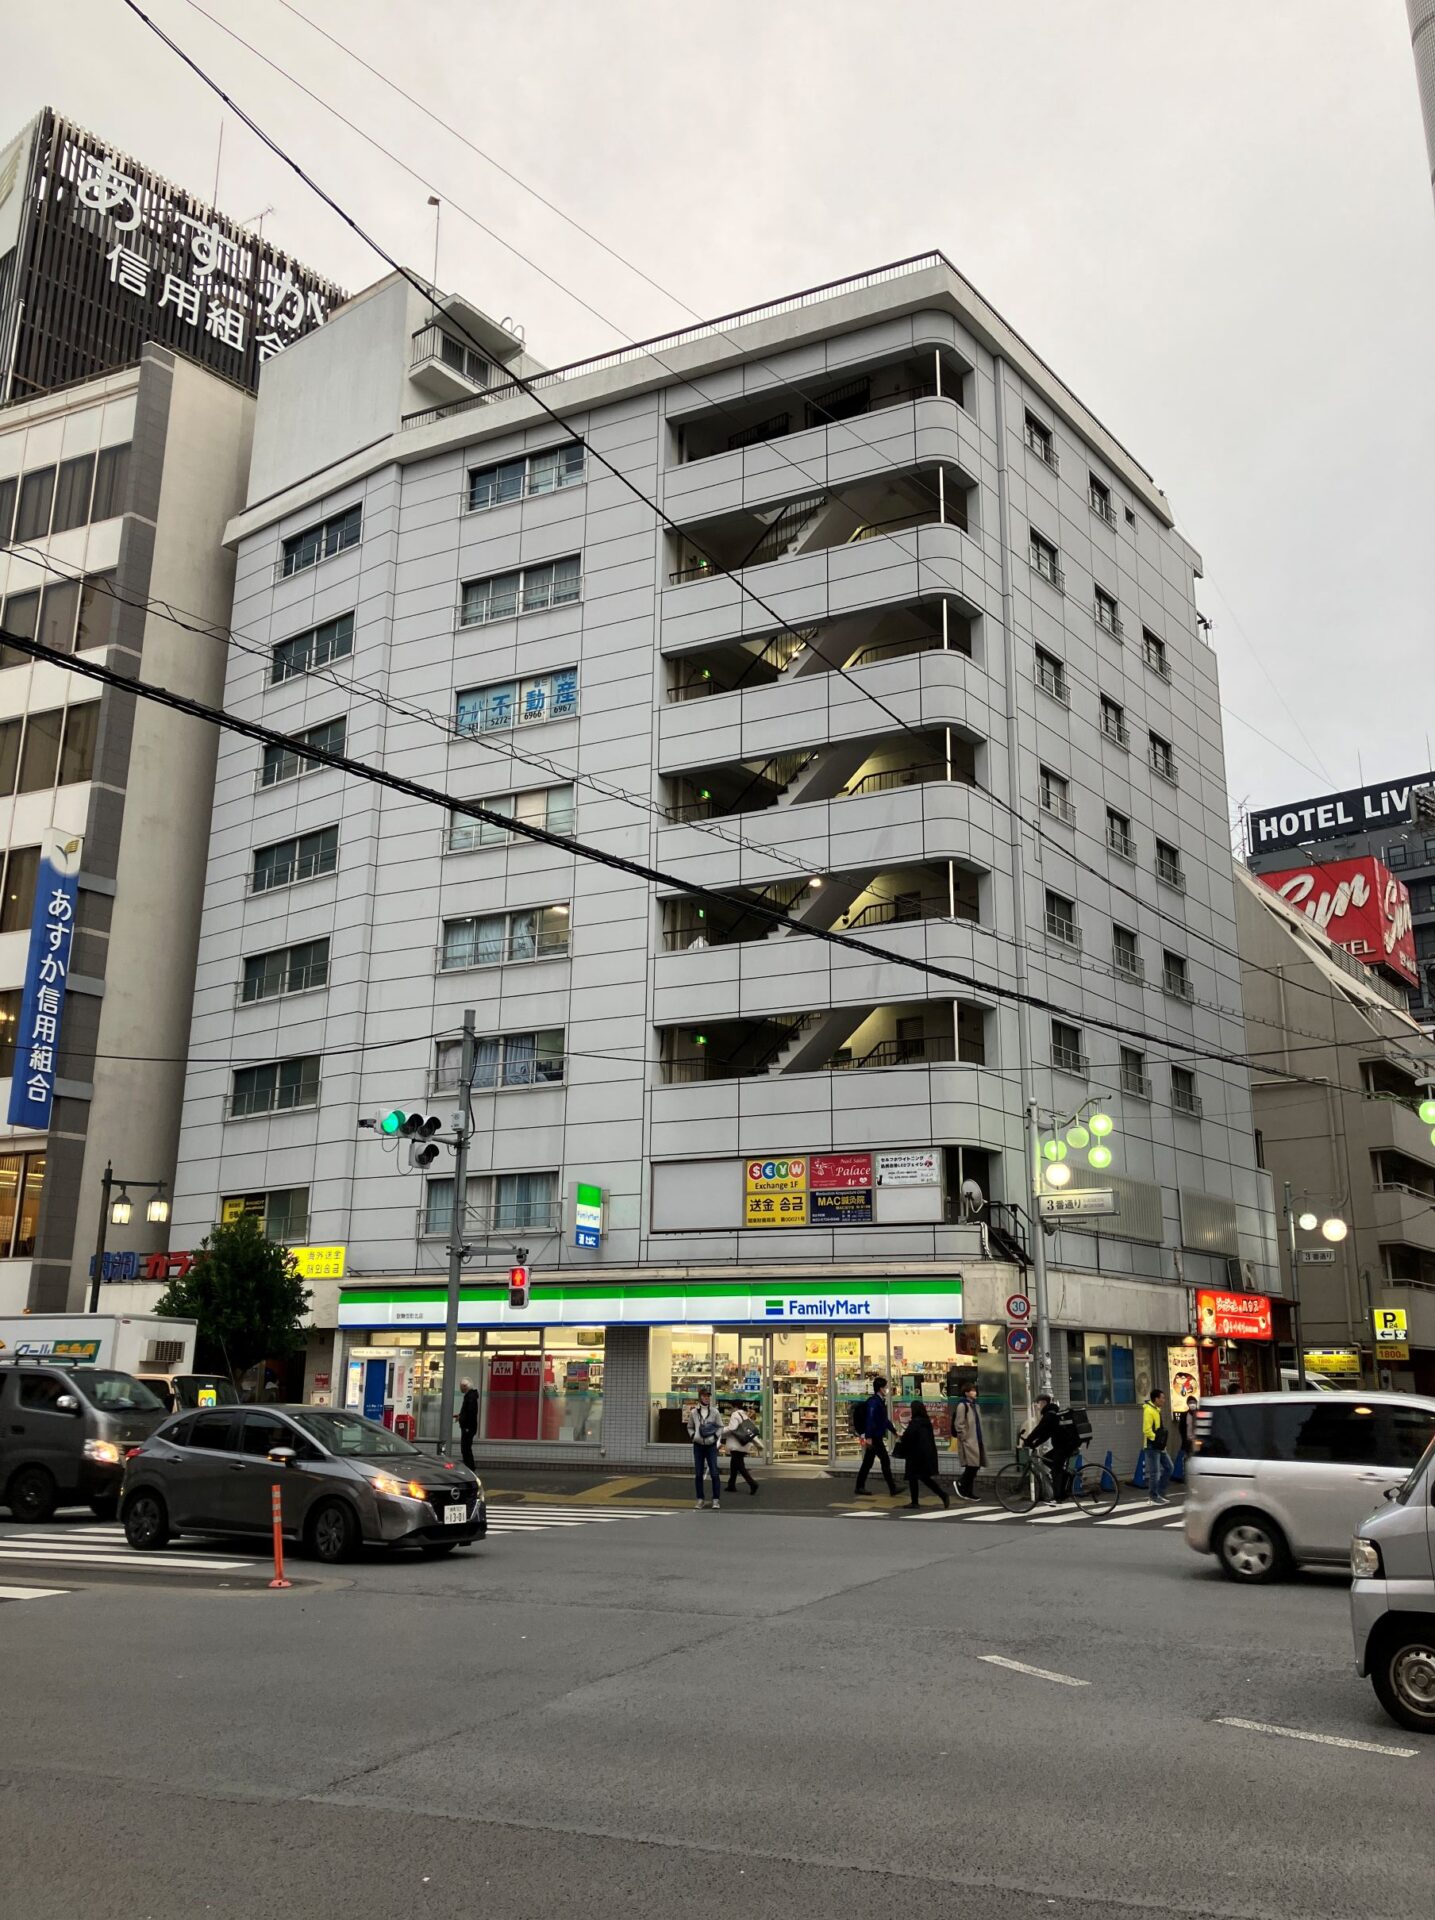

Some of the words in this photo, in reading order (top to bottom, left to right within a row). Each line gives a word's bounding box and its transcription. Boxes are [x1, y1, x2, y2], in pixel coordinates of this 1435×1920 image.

[78, 154, 325, 329] あすか
[554, 703, 572, 714] 6967
[1259, 802, 1353, 841] HOTEL
[1363, 782, 1435, 819] LiV
[27, 888, 72, 1102] あすか信用組合
[835, 1165, 871, 1176] Palace
[755, 1181, 788, 1190] Exchange
[750, 1198, 775, 1212] 送金
[780, 1196, 804, 1211] 송금
[789, 1300, 870, 1317] FamilyMart
[1012, 1301, 1026, 1312] 30
[1383, 1312, 1396, 1328] P
